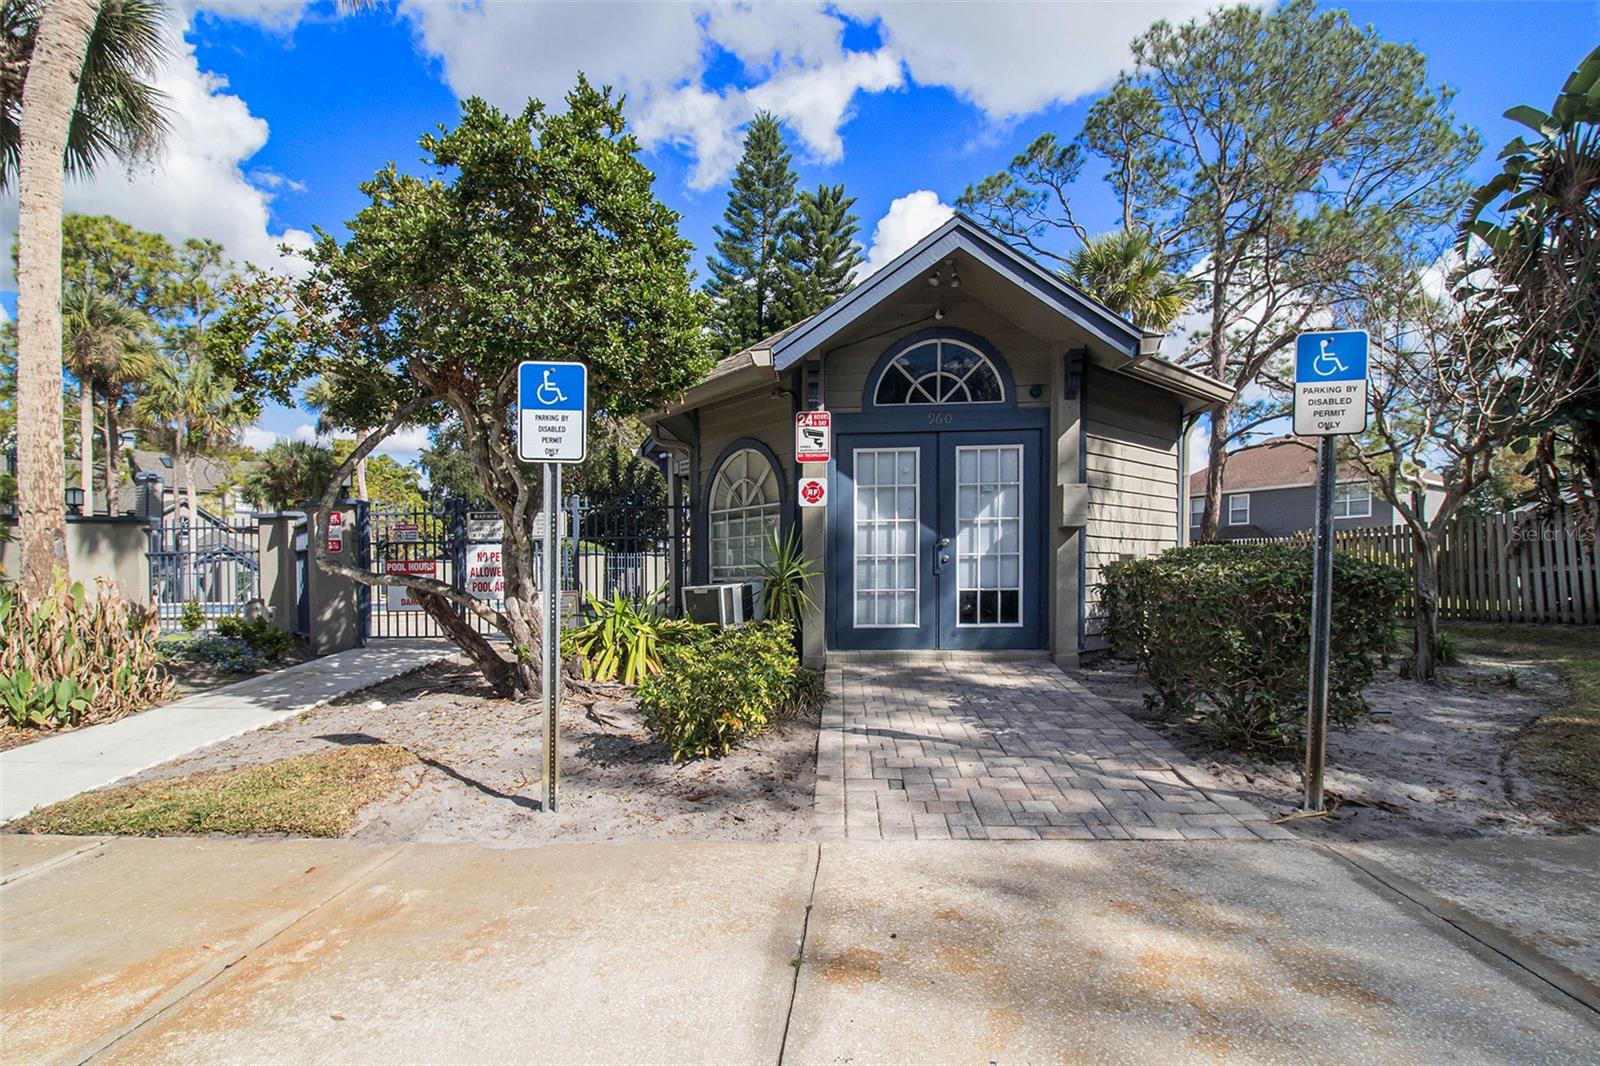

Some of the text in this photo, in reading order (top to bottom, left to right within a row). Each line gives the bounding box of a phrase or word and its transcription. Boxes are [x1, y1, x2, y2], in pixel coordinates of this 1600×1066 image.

[1303, 385, 1358, 394] PARKING BY
[1308, 397, 1352, 406] DISABLED
[1313, 409, 1346, 417] PERMIT
[798, 414, 813, 426] 24
[927, 412, 953, 425] 960
[538, 425, 567, 433] DISABLED
[1317, 421, 1341, 429] ONLY
[545, 447, 559, 455] ONLY
[807, 488, 818, 496] RF
[477, 552, 501, 562] NO PE
[386, 562, 434, 571] POOL HOURS
[472, 581, 505, 592] POOL AR
